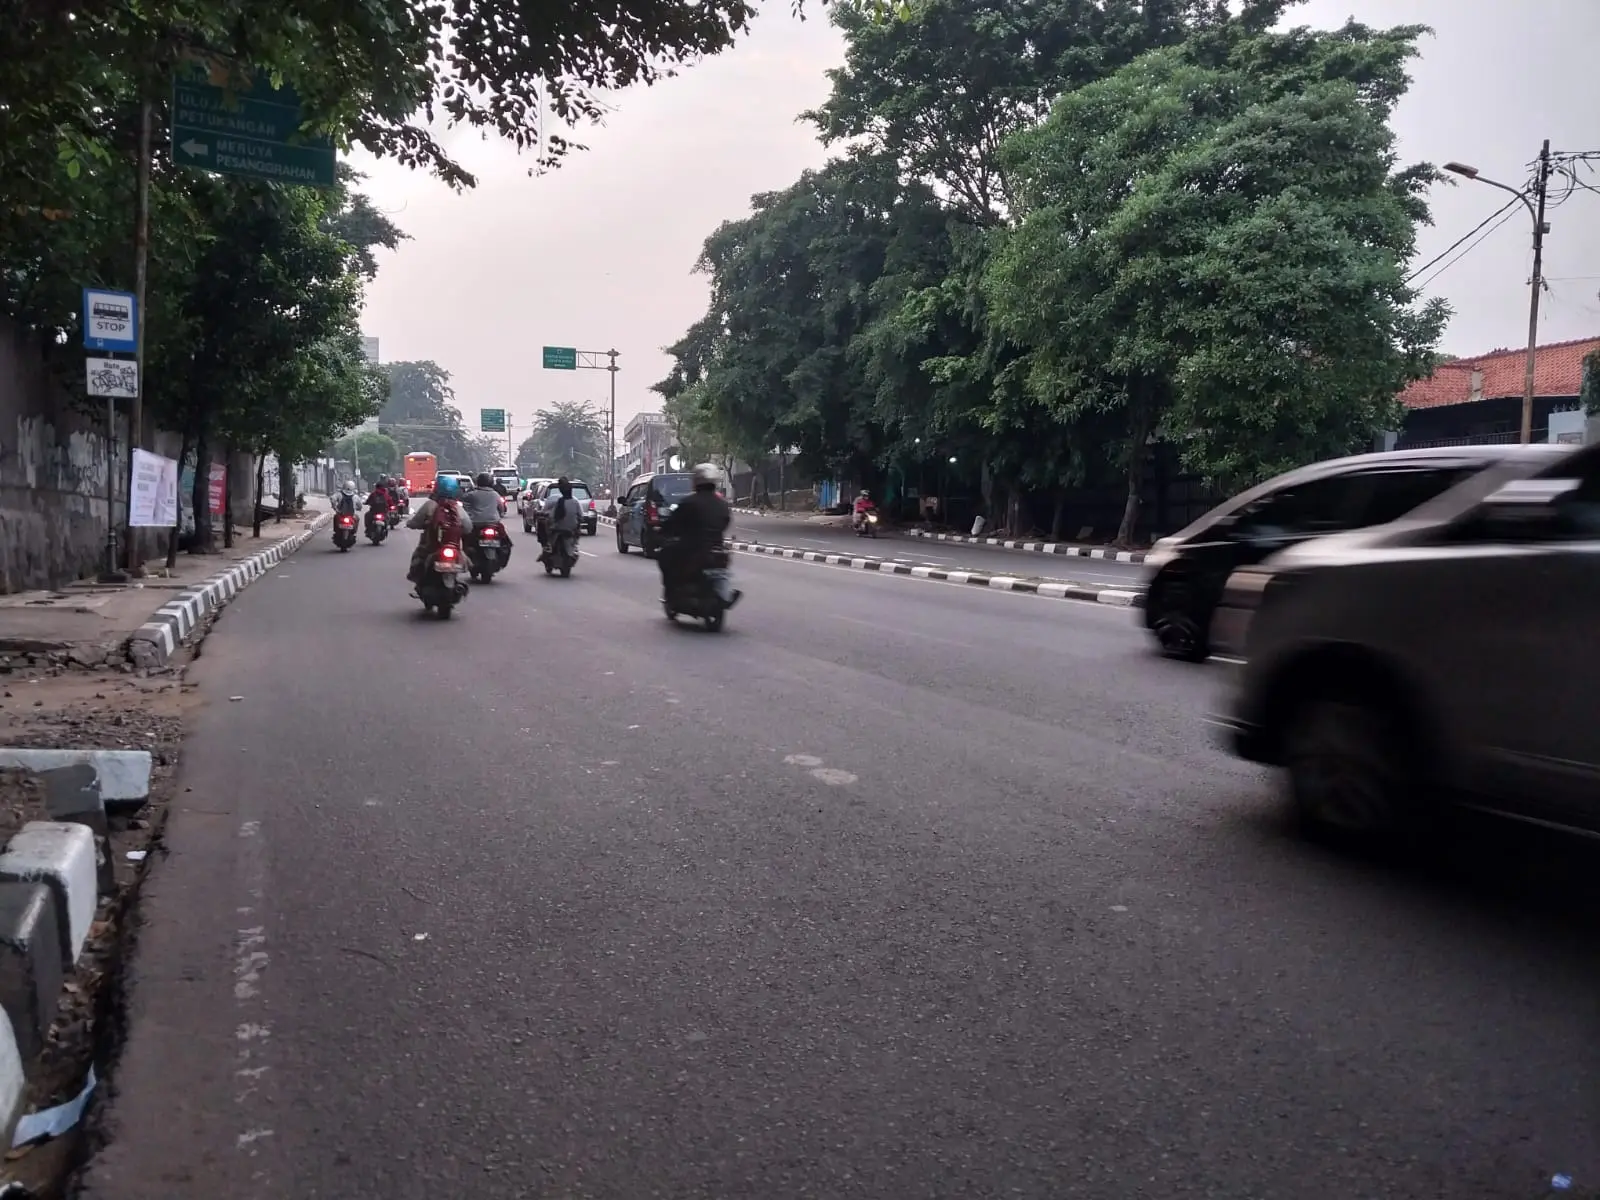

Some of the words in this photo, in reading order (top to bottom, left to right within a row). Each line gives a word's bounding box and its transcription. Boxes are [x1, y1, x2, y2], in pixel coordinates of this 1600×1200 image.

[179, 109, 277, 136] PETUKANGAN
[217, 139, 273, 159] MERUYA
[216, 153, 316, 180] PESANGGRAHAN
[97, 321, 125, 332] STOP
